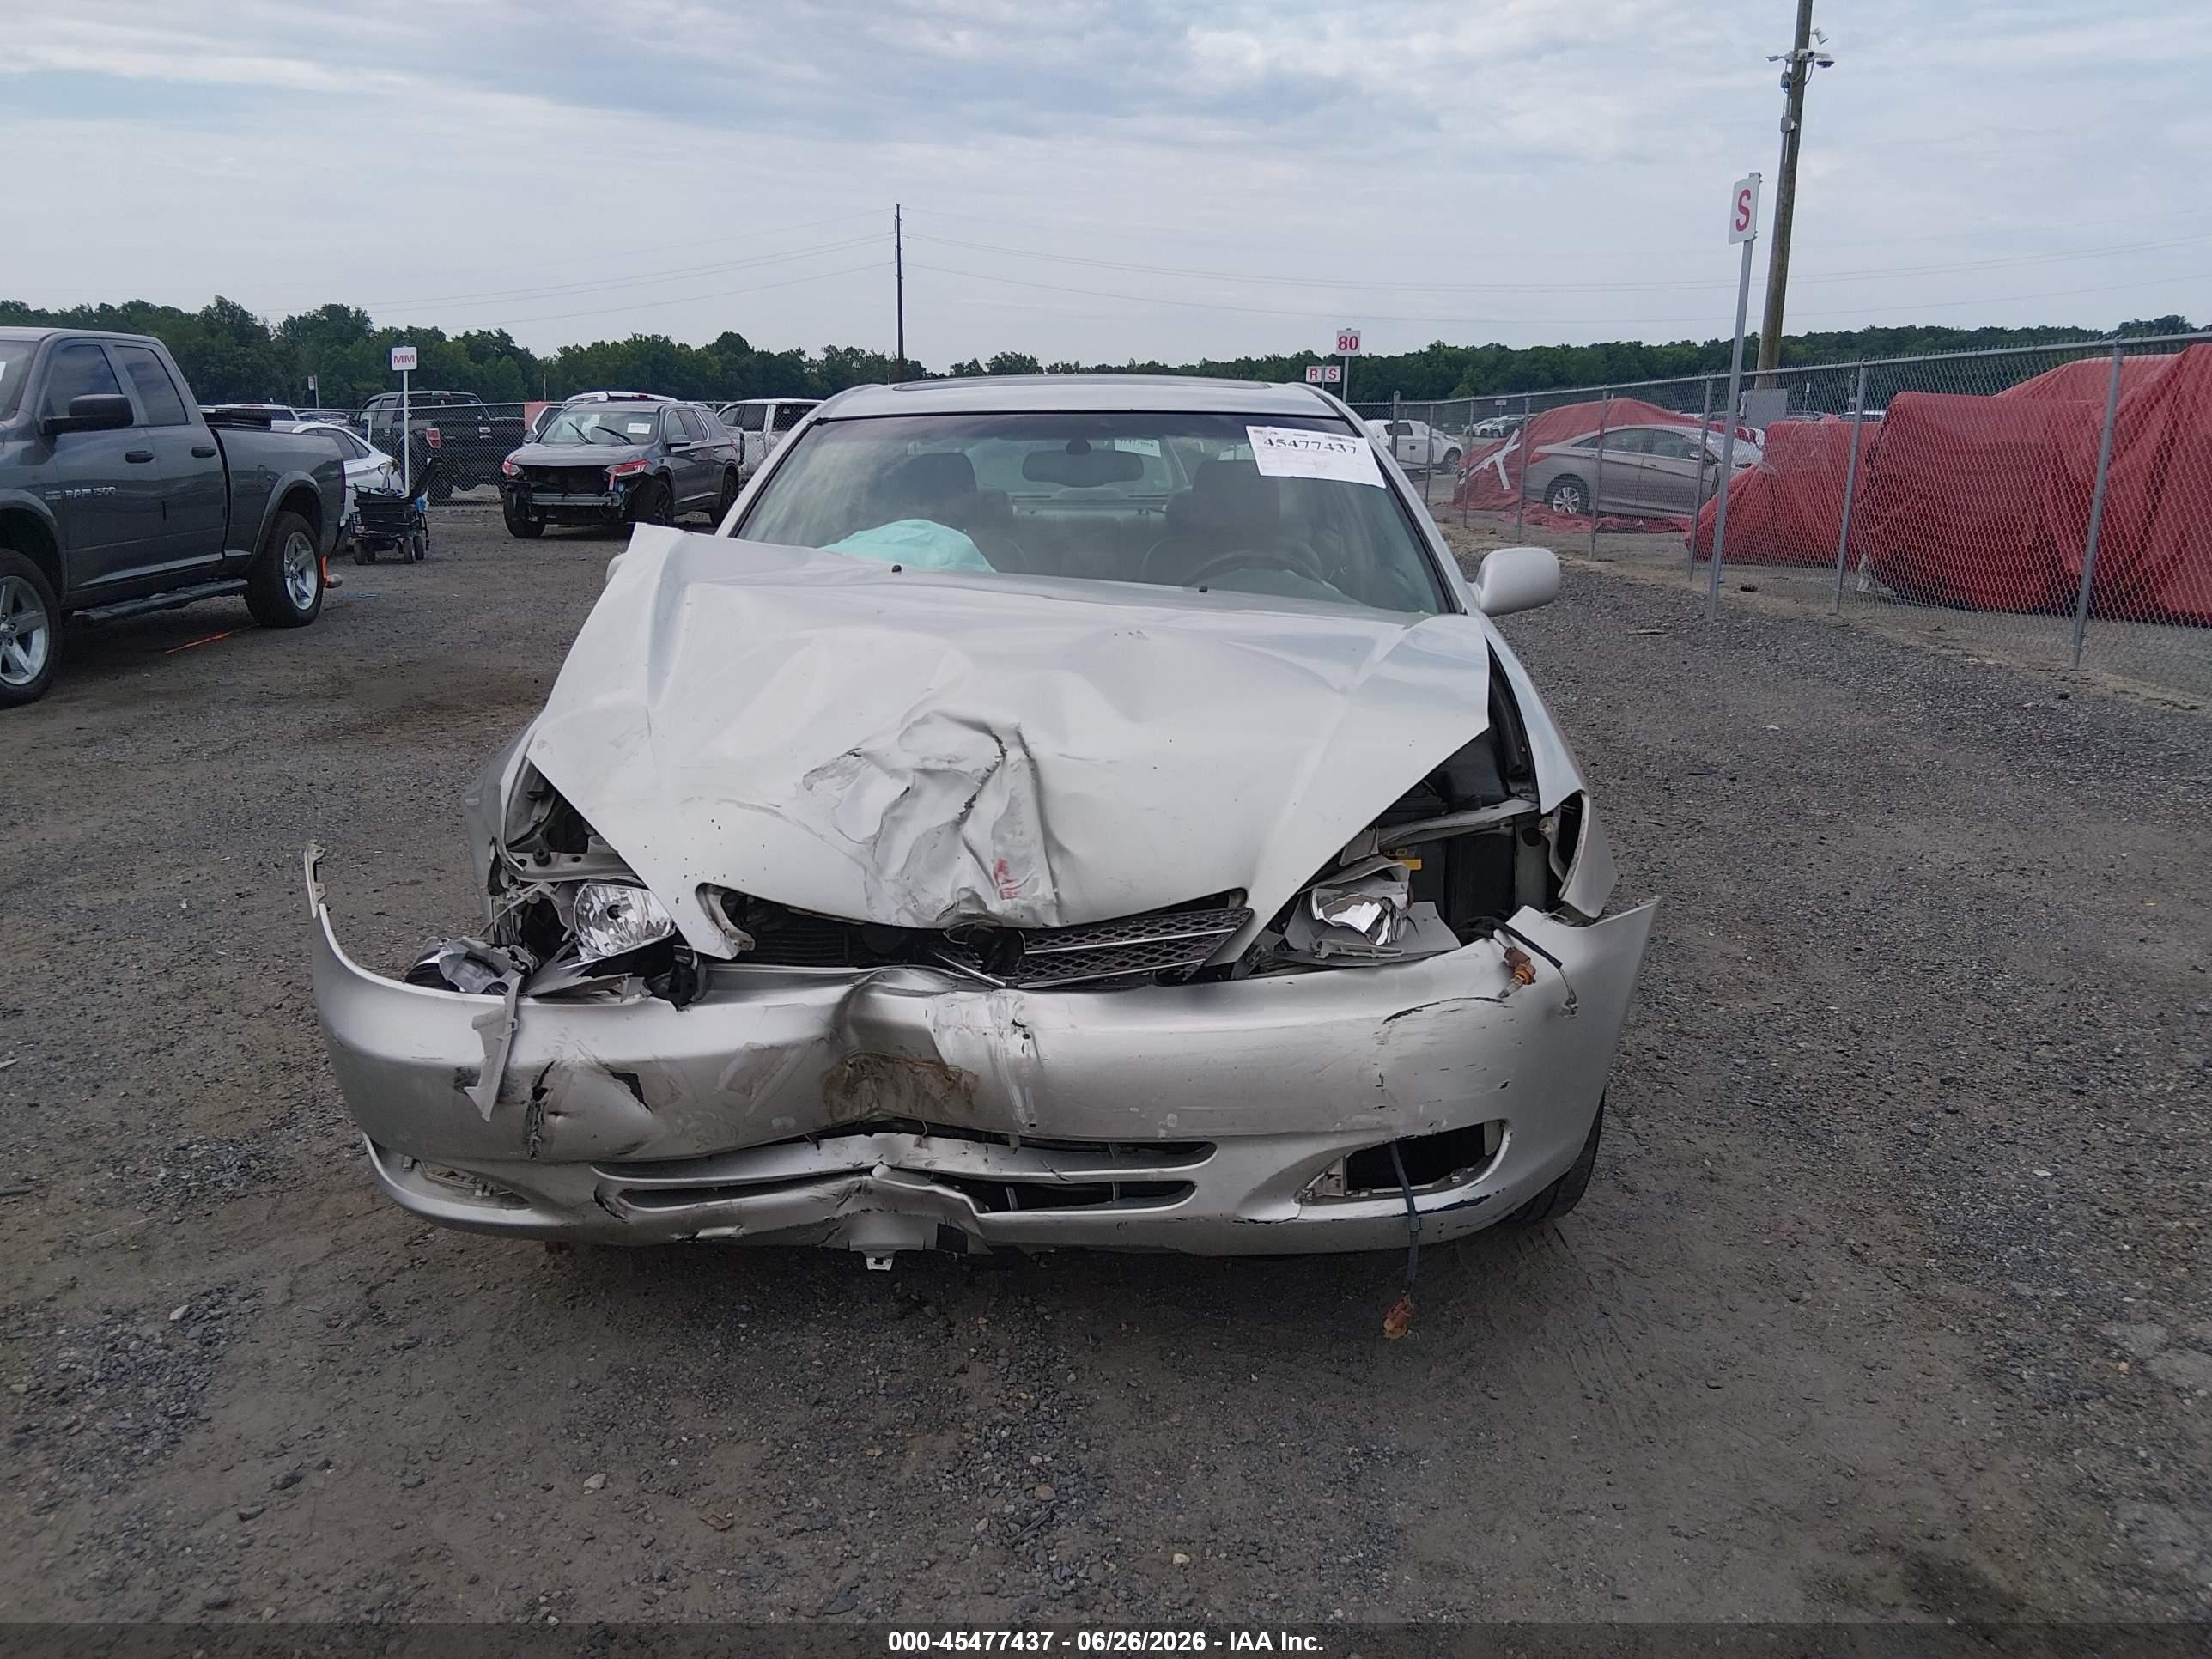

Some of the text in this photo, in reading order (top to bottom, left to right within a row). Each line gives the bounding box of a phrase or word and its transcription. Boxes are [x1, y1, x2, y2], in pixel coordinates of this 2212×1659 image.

[1735, 188, 1751, 232] S
[1338, 335, 1358, 351] 80
[393, 355, 415, 364] MM
[1310, 368, 1318, 380] R
[1328, 368, 1337, 380] S
[1263, 437, 1357, 454] 45477437
